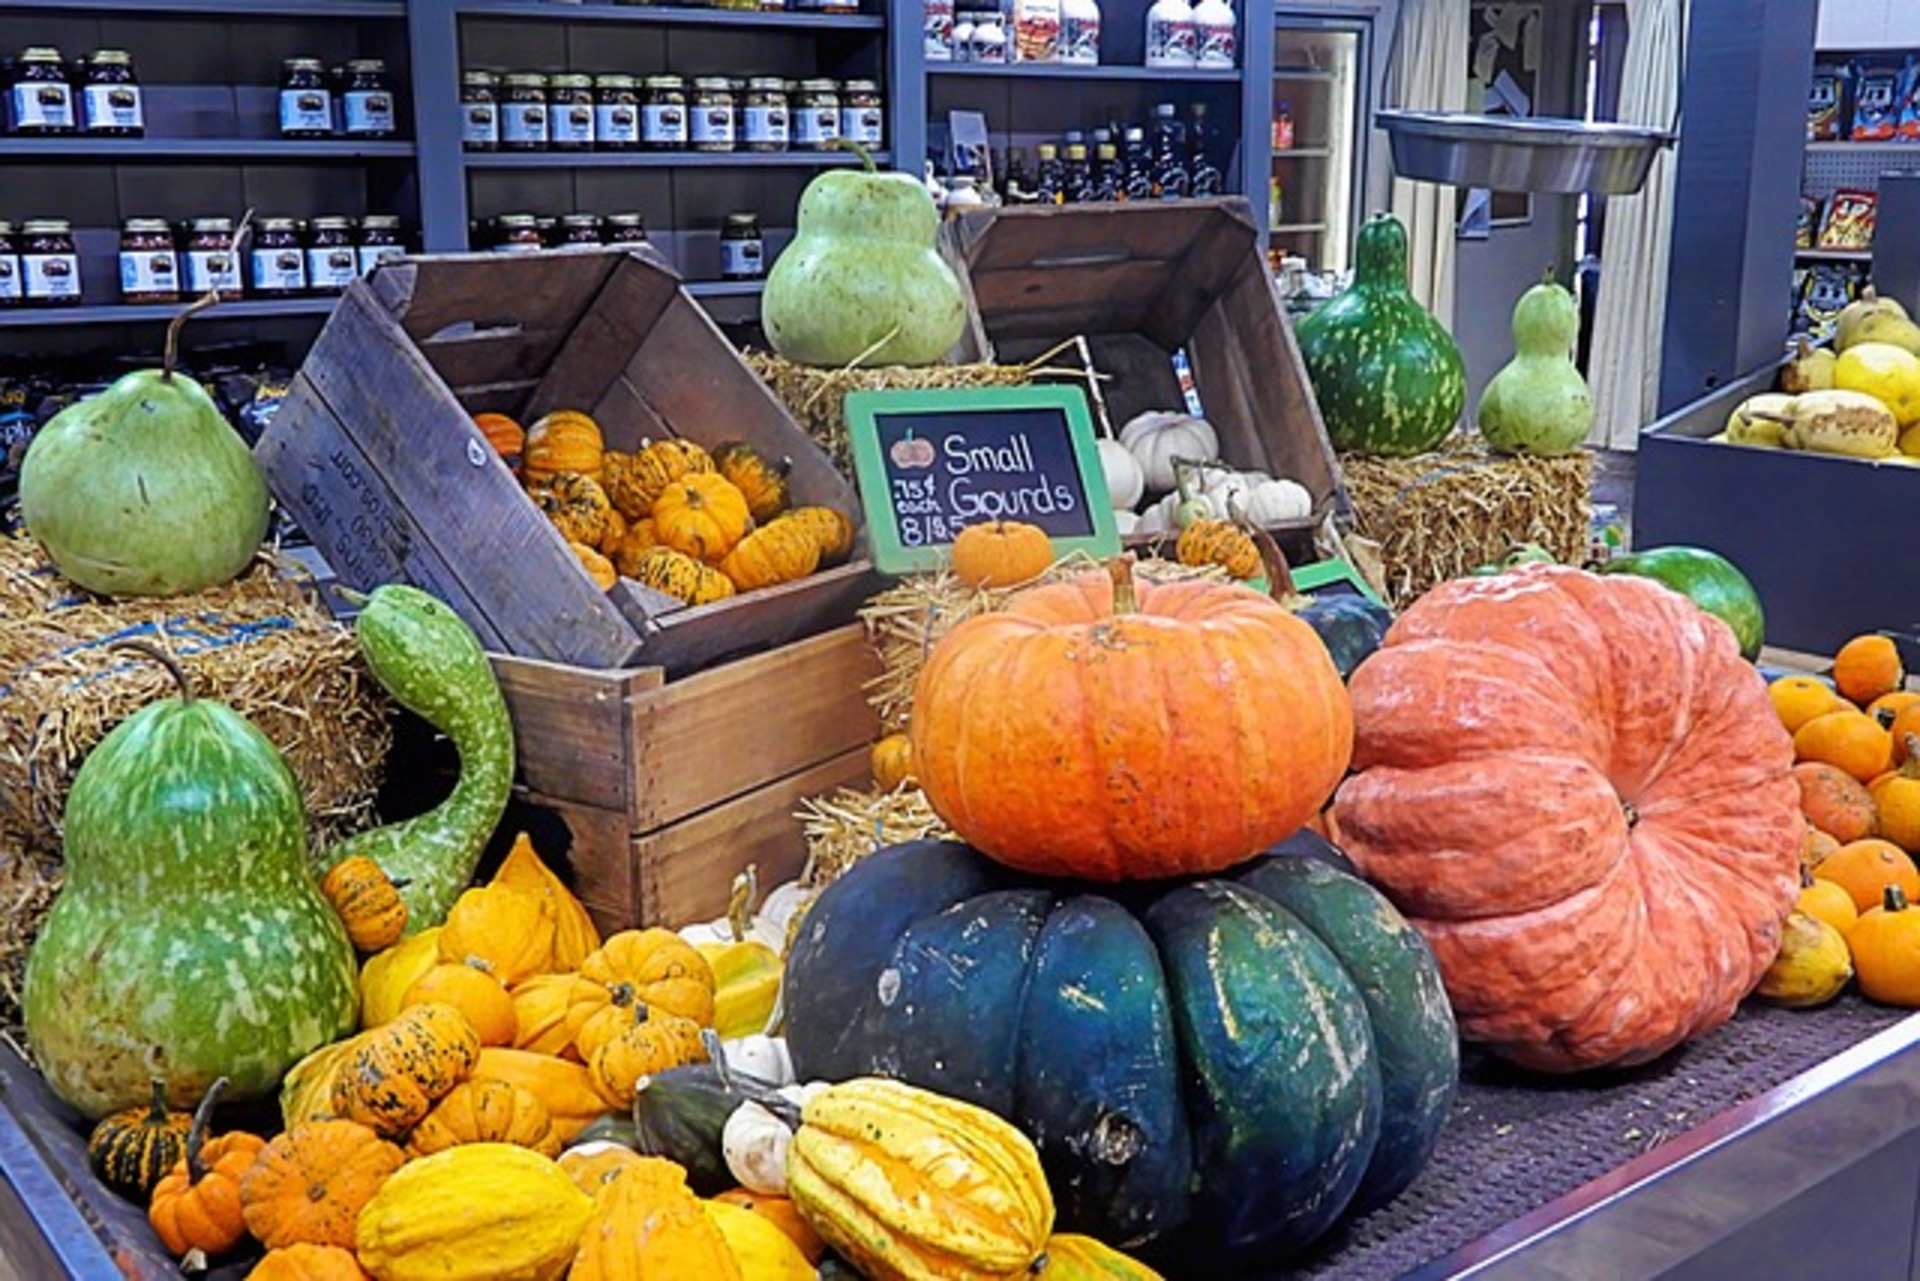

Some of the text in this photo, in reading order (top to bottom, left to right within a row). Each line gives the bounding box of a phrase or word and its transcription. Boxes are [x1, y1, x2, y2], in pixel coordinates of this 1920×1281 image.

[944, 433, 1034, 475] Small
[897, 498, 942, 514] each
[948, 474, 1075, 518] Gourds
